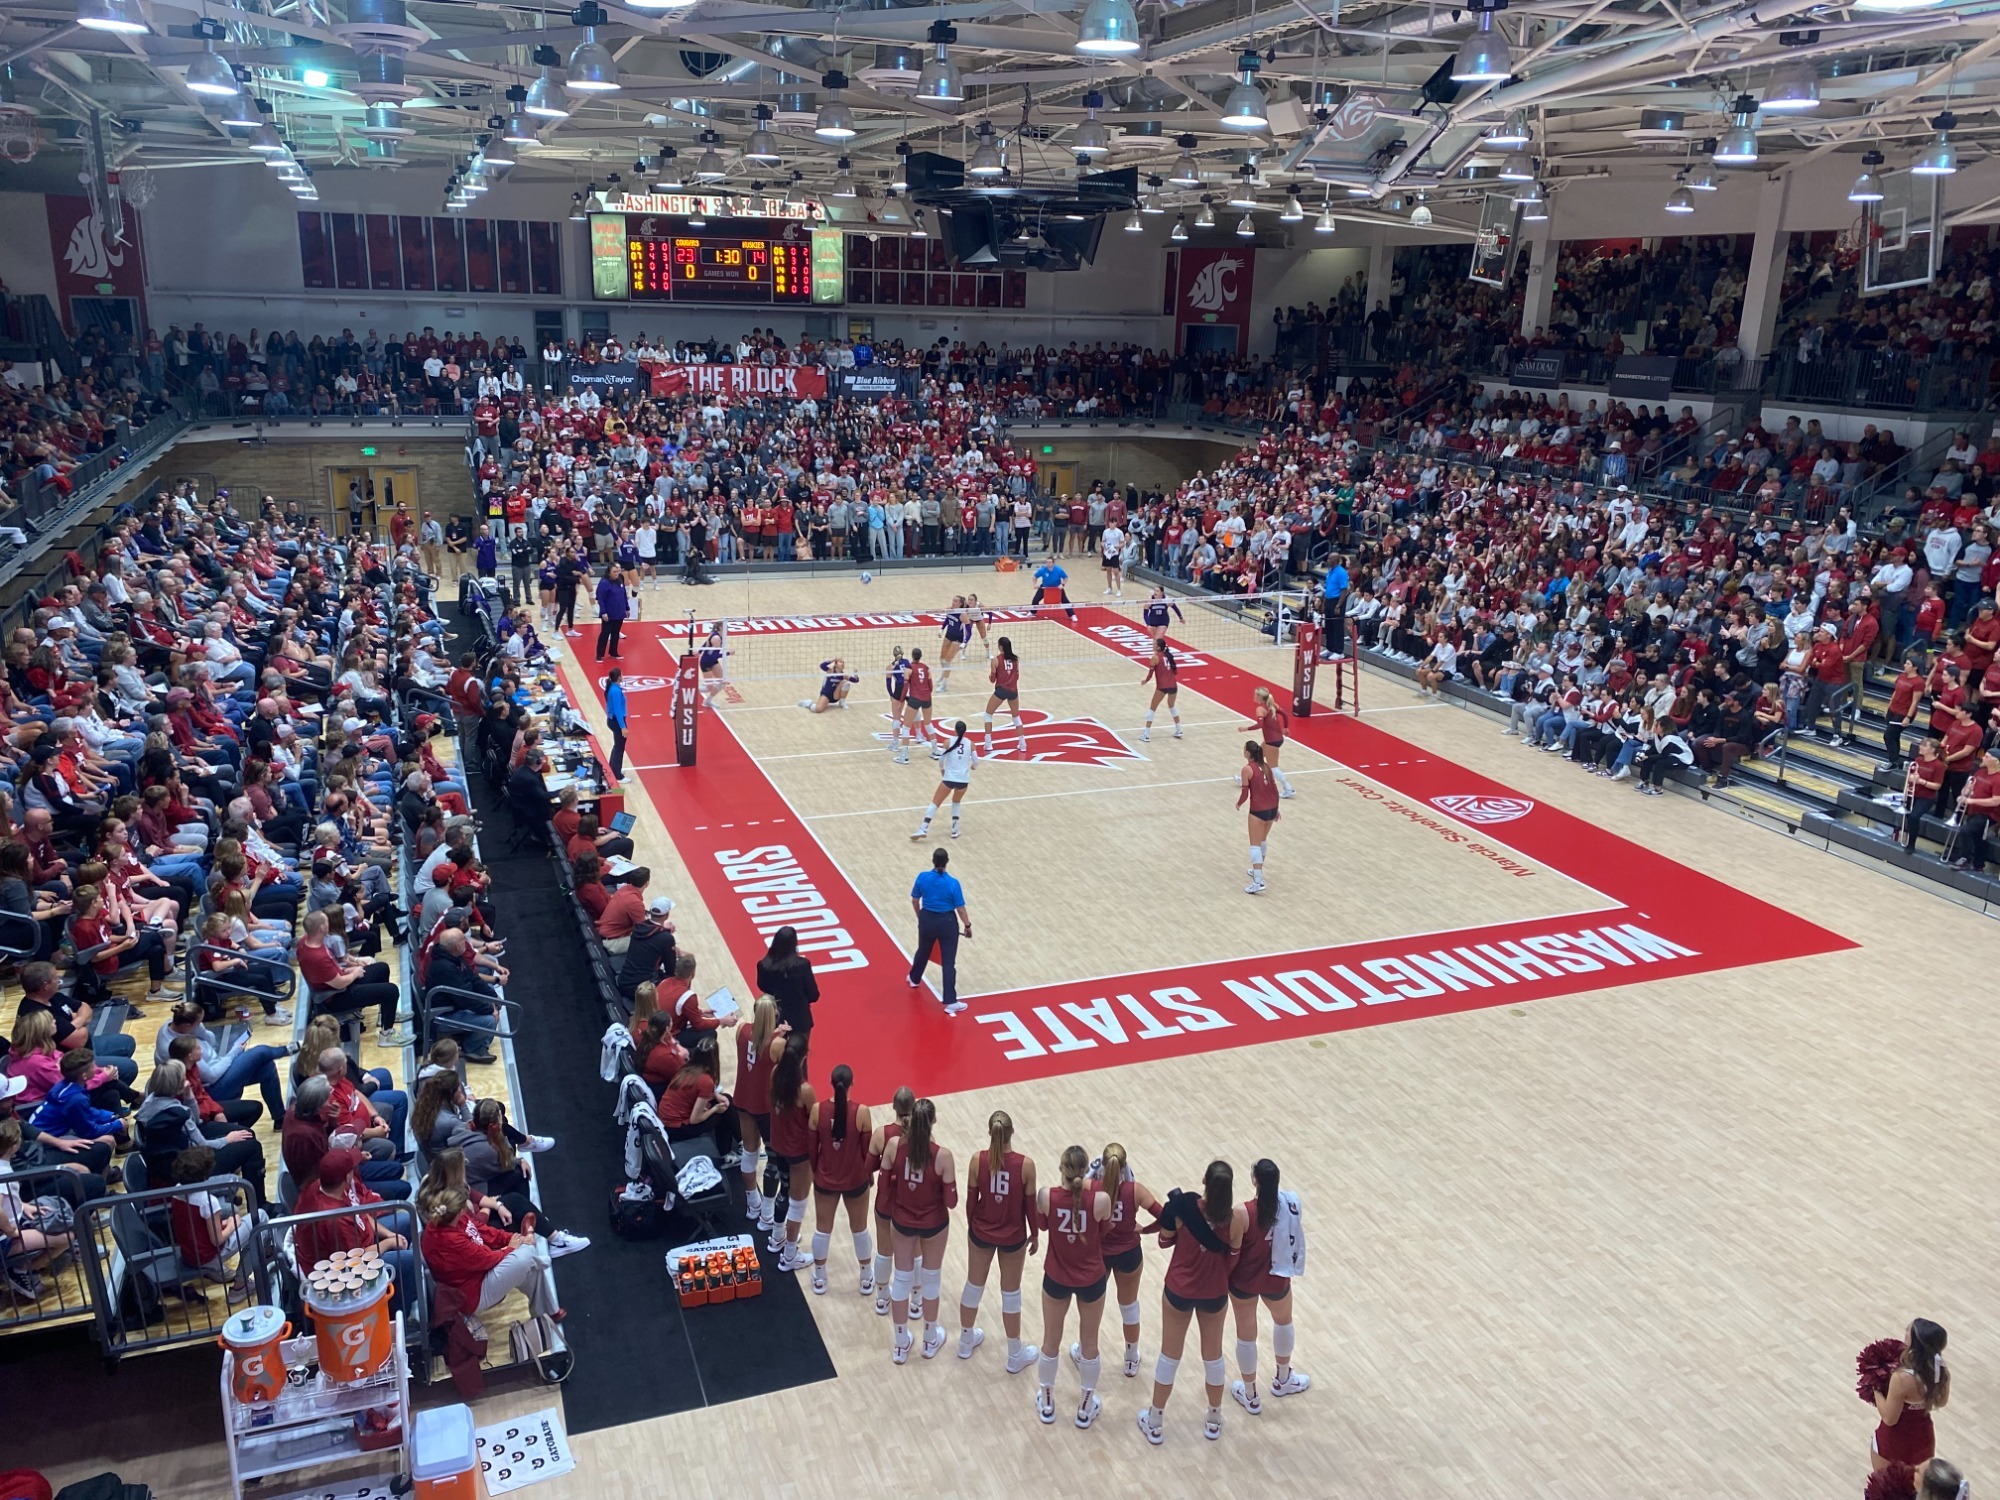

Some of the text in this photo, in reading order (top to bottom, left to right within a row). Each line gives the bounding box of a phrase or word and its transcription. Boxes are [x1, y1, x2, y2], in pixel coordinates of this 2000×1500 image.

[760, 199, 823, 219] OUGAS
[630, 241, 642, 251] 05
[675, 239, 700, 247] COUGARS
[742, 241, 765, 249] HUSKIES
[676, 248, 765, 264] 23 1:30 14
[686, 264, 758, 280] 0 GAMES WON 0
[1518, 360, 1556, 371] SAM DIAL
[571, 374, 634, 385] Chipman&Taylor
[684, 366, 725, 393] THE
[855, 376, 896, 385] Blue Ribbon
[917, 668, 925, 679] 5
[1003, 659, 1013, 670] 15
[1303, 650, 1313, 699] WSU
[682, 688, 696, 745] WSU
[957, 743, 964, 755] 3
[1336, 777, 1536, 877] Marcia Saneholtz Court
[714, 845, 869, 974] COUGARS
[974, 924, 1703, 1060] WASHINGTON STATE
[990, 1170, 1010, 1195] 16
[1056, 1208, 1087, 1233] 20
[686, 1244, 739, 1253] GATORADE
[341, 1323, 366, 1346] G
[242, 1355, 264, 1376] G
[541, 1420, 560, 1462] GATORADE
